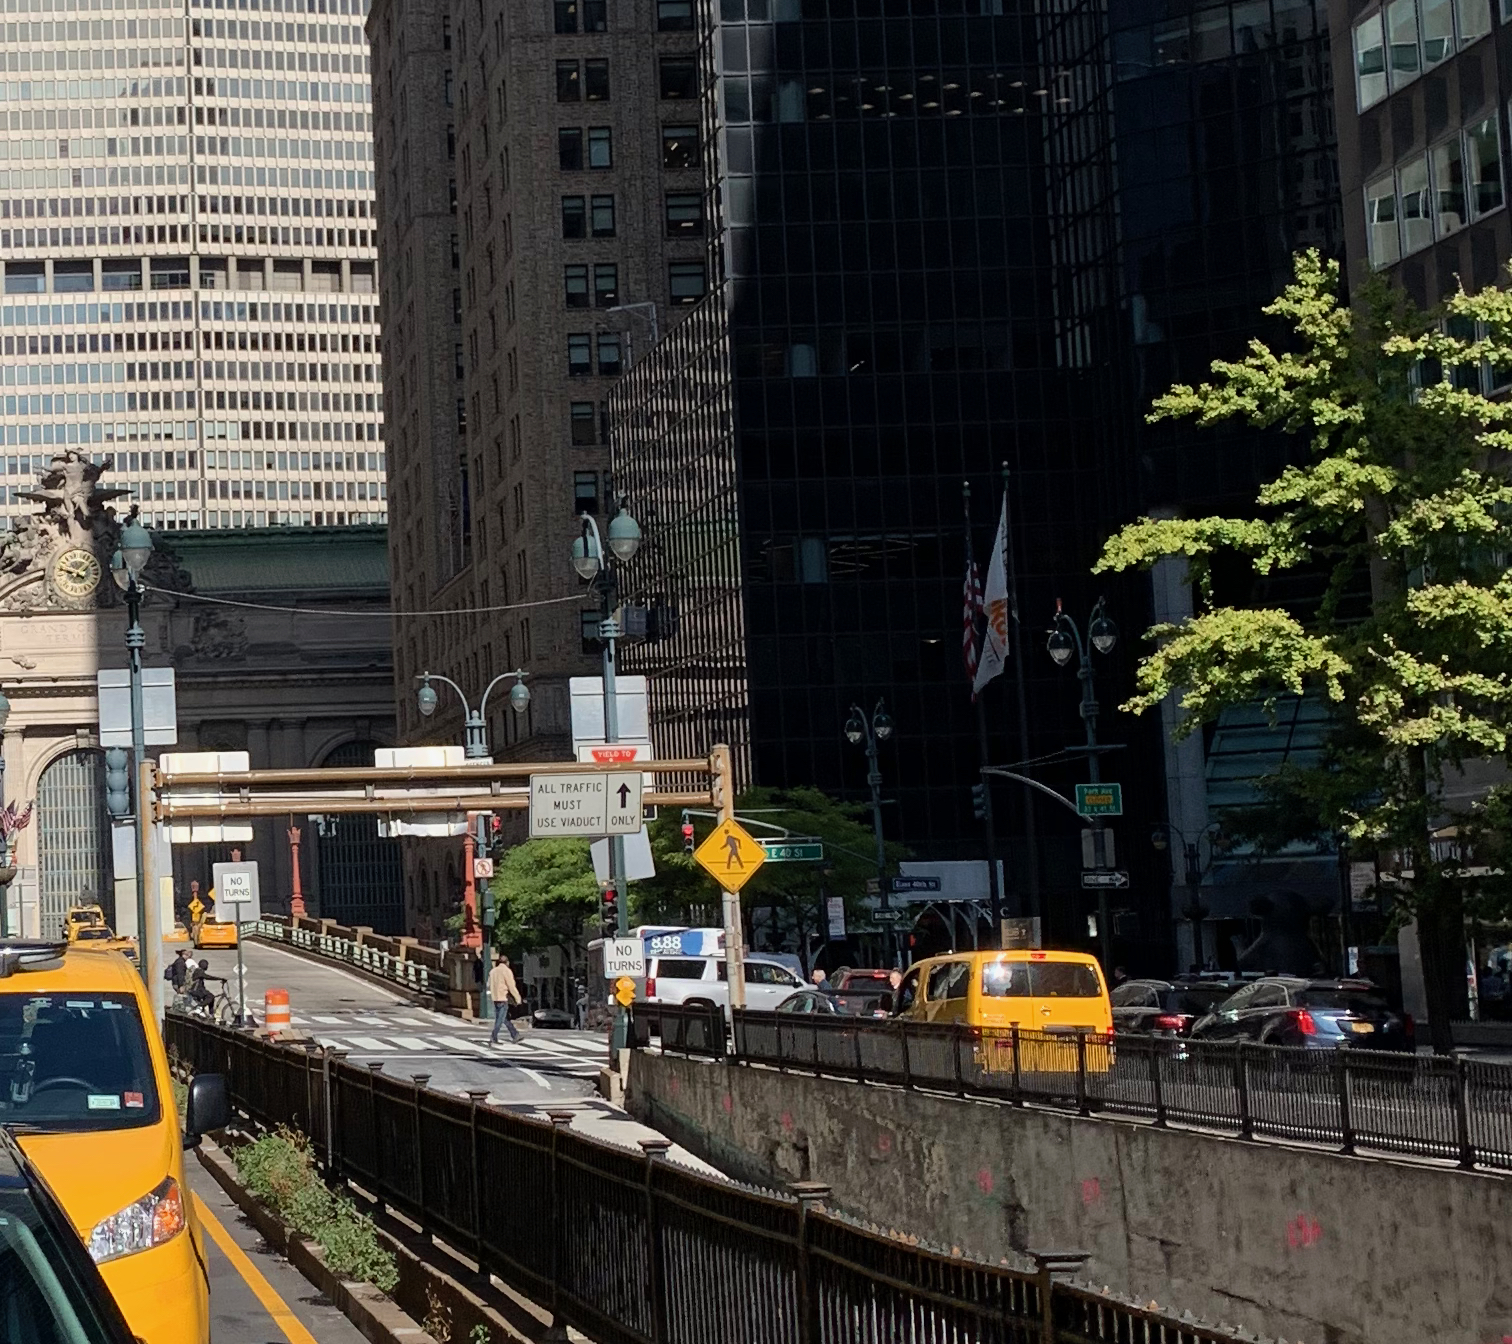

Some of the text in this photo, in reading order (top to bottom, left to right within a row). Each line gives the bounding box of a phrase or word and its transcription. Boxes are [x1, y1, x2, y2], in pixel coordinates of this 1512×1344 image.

[538, 782, 602, 794] ALL TRAFFIC
[553, 799, 582, 810] MUST
[537, 816, 602, 828] USE VIADUCT
[611, 815, 636, 826] ONLY
[771, 848, 803, 858] E 40 St
[230, 876, 243, 886] NO
[224, 887, 250, 897] TURNS
[651, 935, 682, 949] 8.88
[615, 945, 633, 956] NO
[607, 960, 643, 971] TURNS
